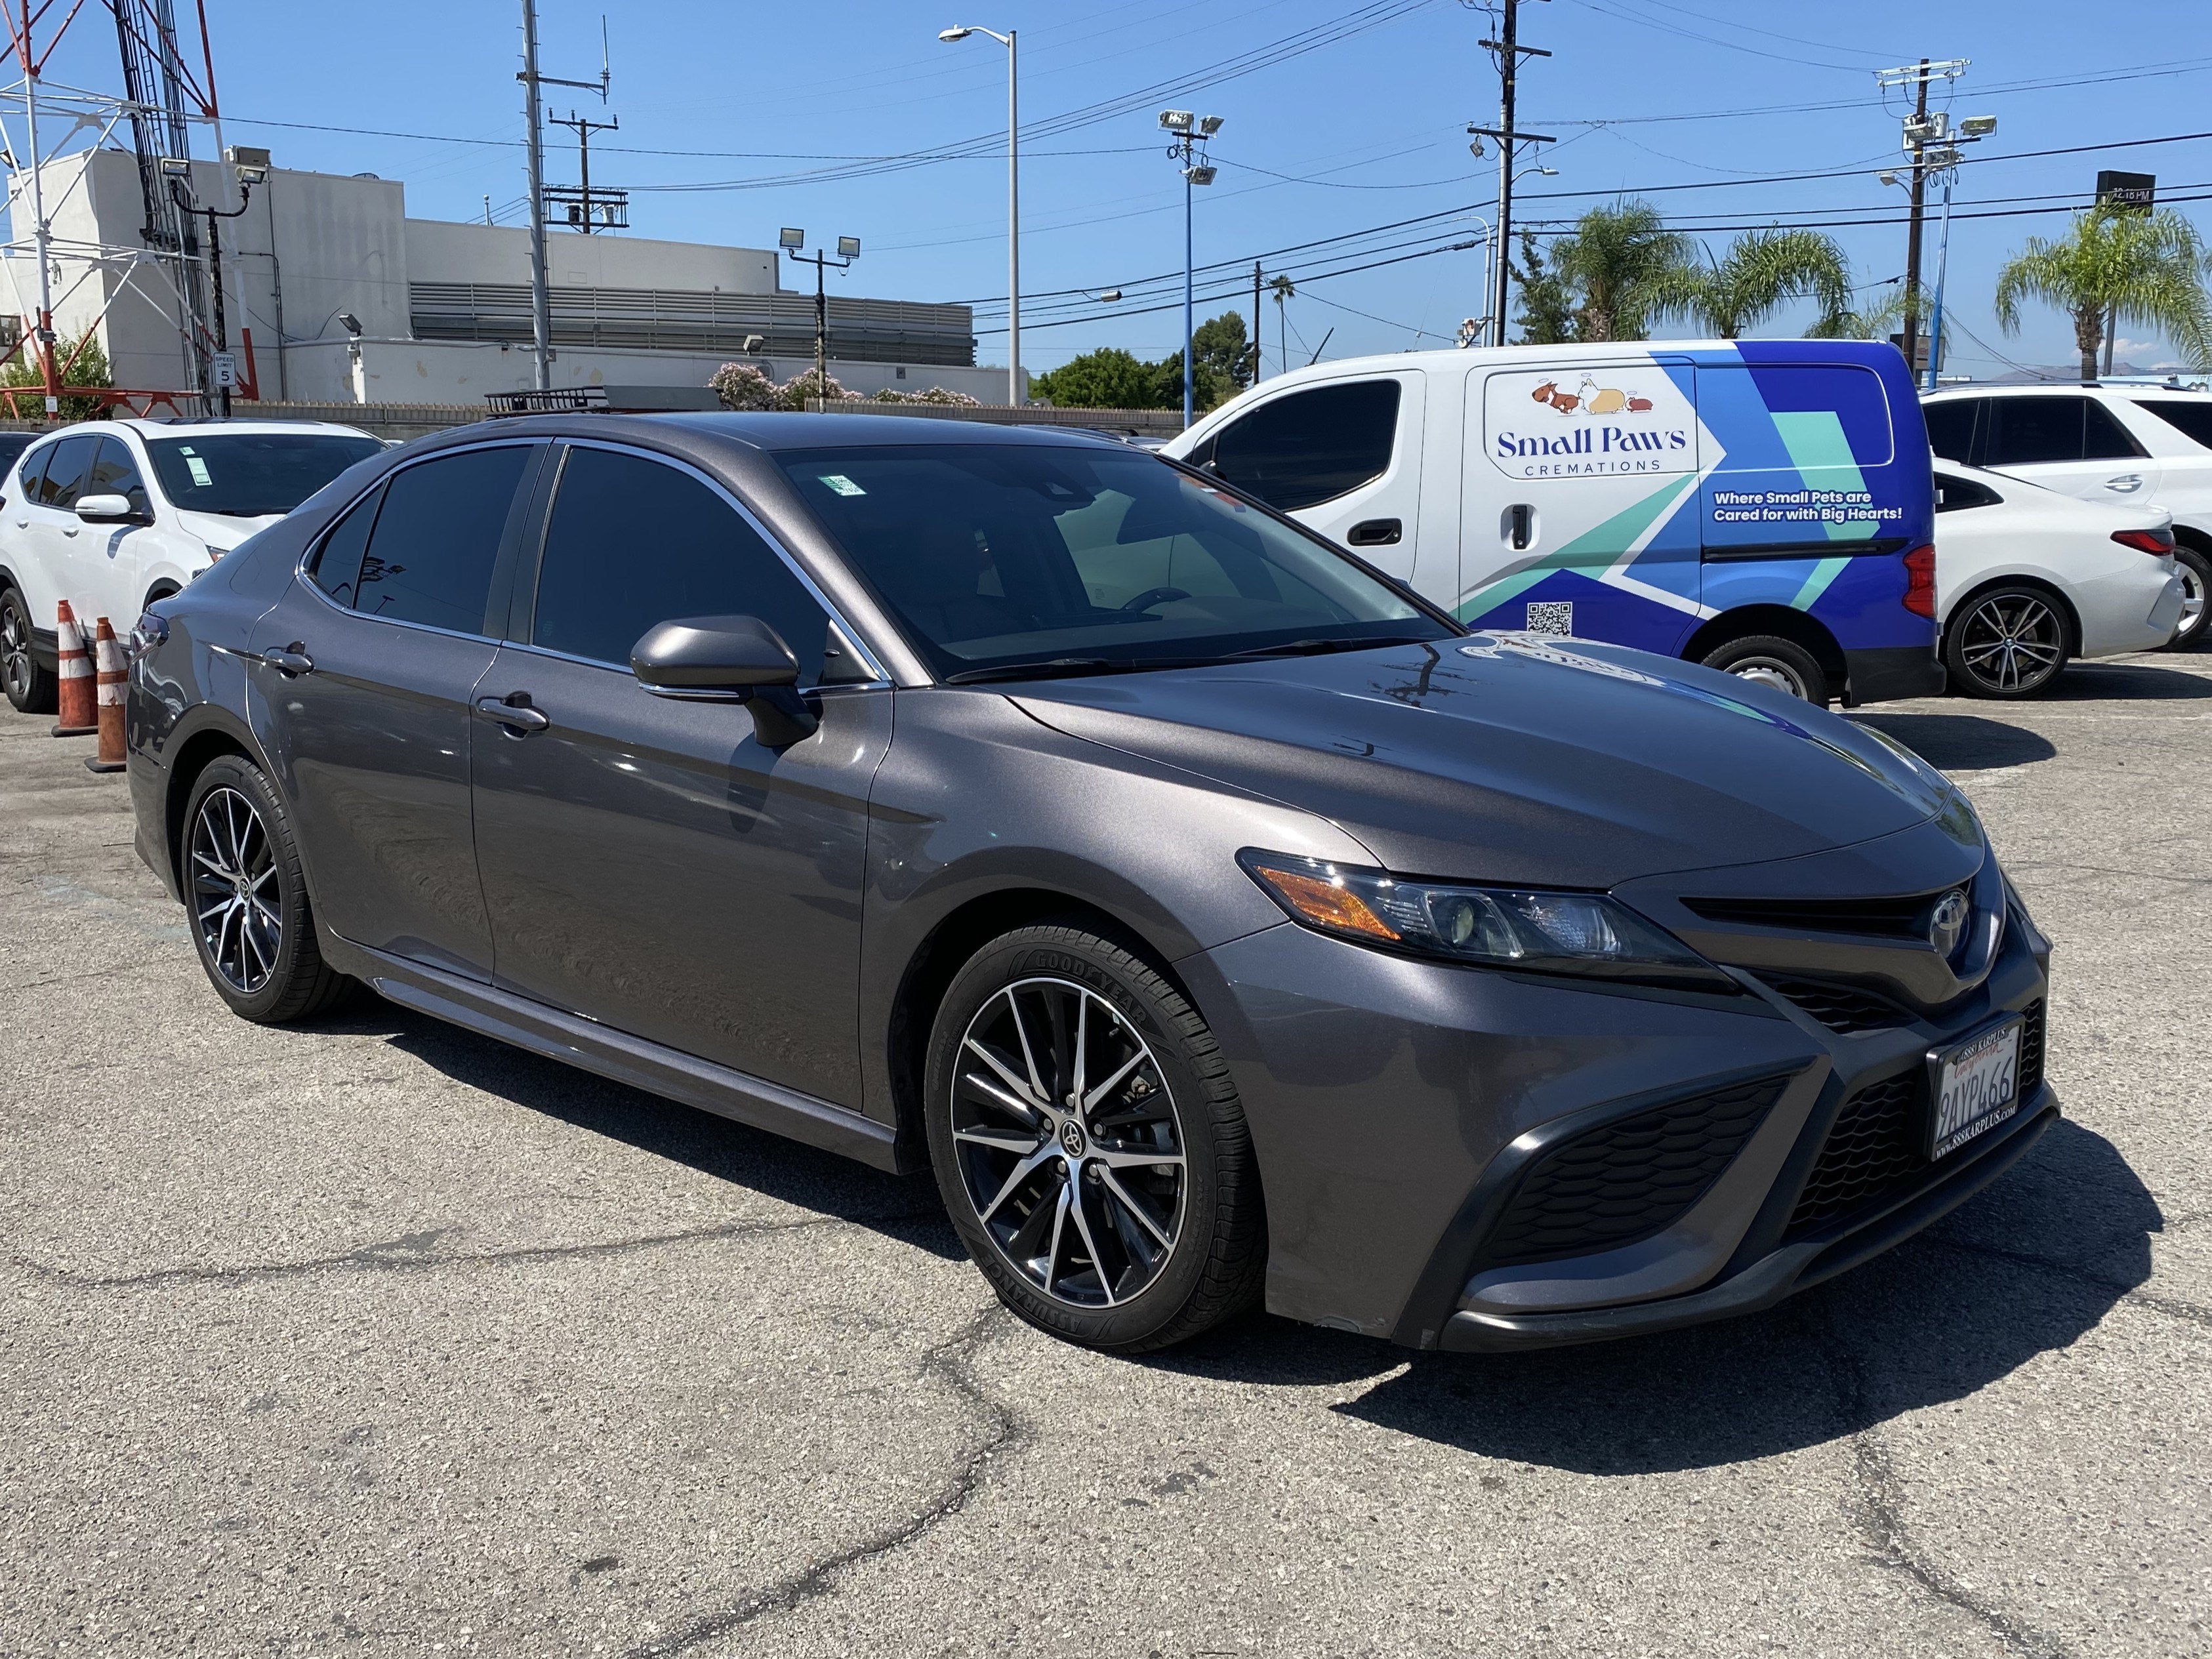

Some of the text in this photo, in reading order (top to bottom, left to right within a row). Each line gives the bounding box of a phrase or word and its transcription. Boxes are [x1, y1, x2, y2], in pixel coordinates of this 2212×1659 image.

[2136, 190, 2150, 201] PM
[221, 371, 230, 381] 5
[1498, 426, 1687, 458] Small Paws
[1525, 460, 1660, 476] CREMATIONS
[1715, 491, 1872, 504] Where Small Pets are
[1714, 507, 1902, 522] Cared for with Big Hearts!
[1977, 1027, 2007, 1052] KARPLUS
[1937, 1055, 2013, 1143] 9AYP466
[981, 1253, 1083, 1333] ASSURANCE
